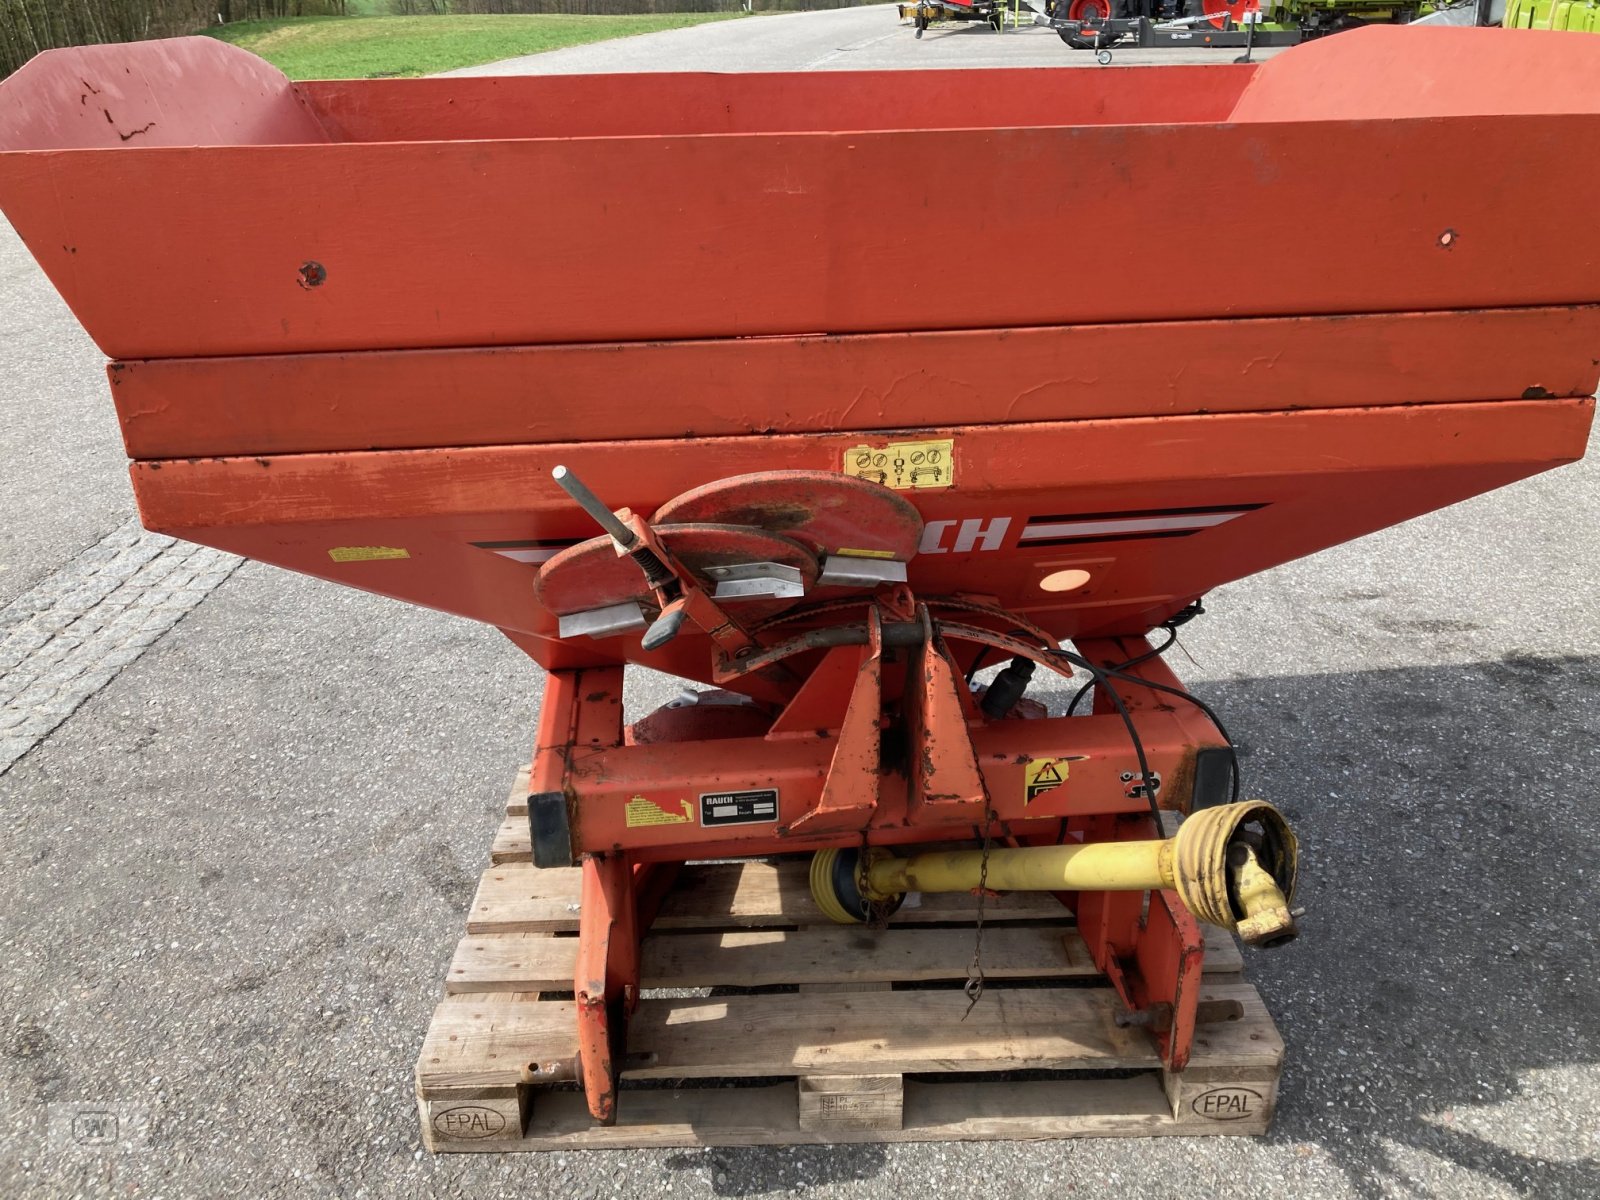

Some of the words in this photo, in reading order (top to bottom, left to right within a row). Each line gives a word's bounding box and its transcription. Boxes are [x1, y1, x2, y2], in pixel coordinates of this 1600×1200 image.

[706, 796, 733, 806] RAUCH
[1203, 1094, 1254, 1113] EPAL
[445, 1113, 497, 1132] EPAL
